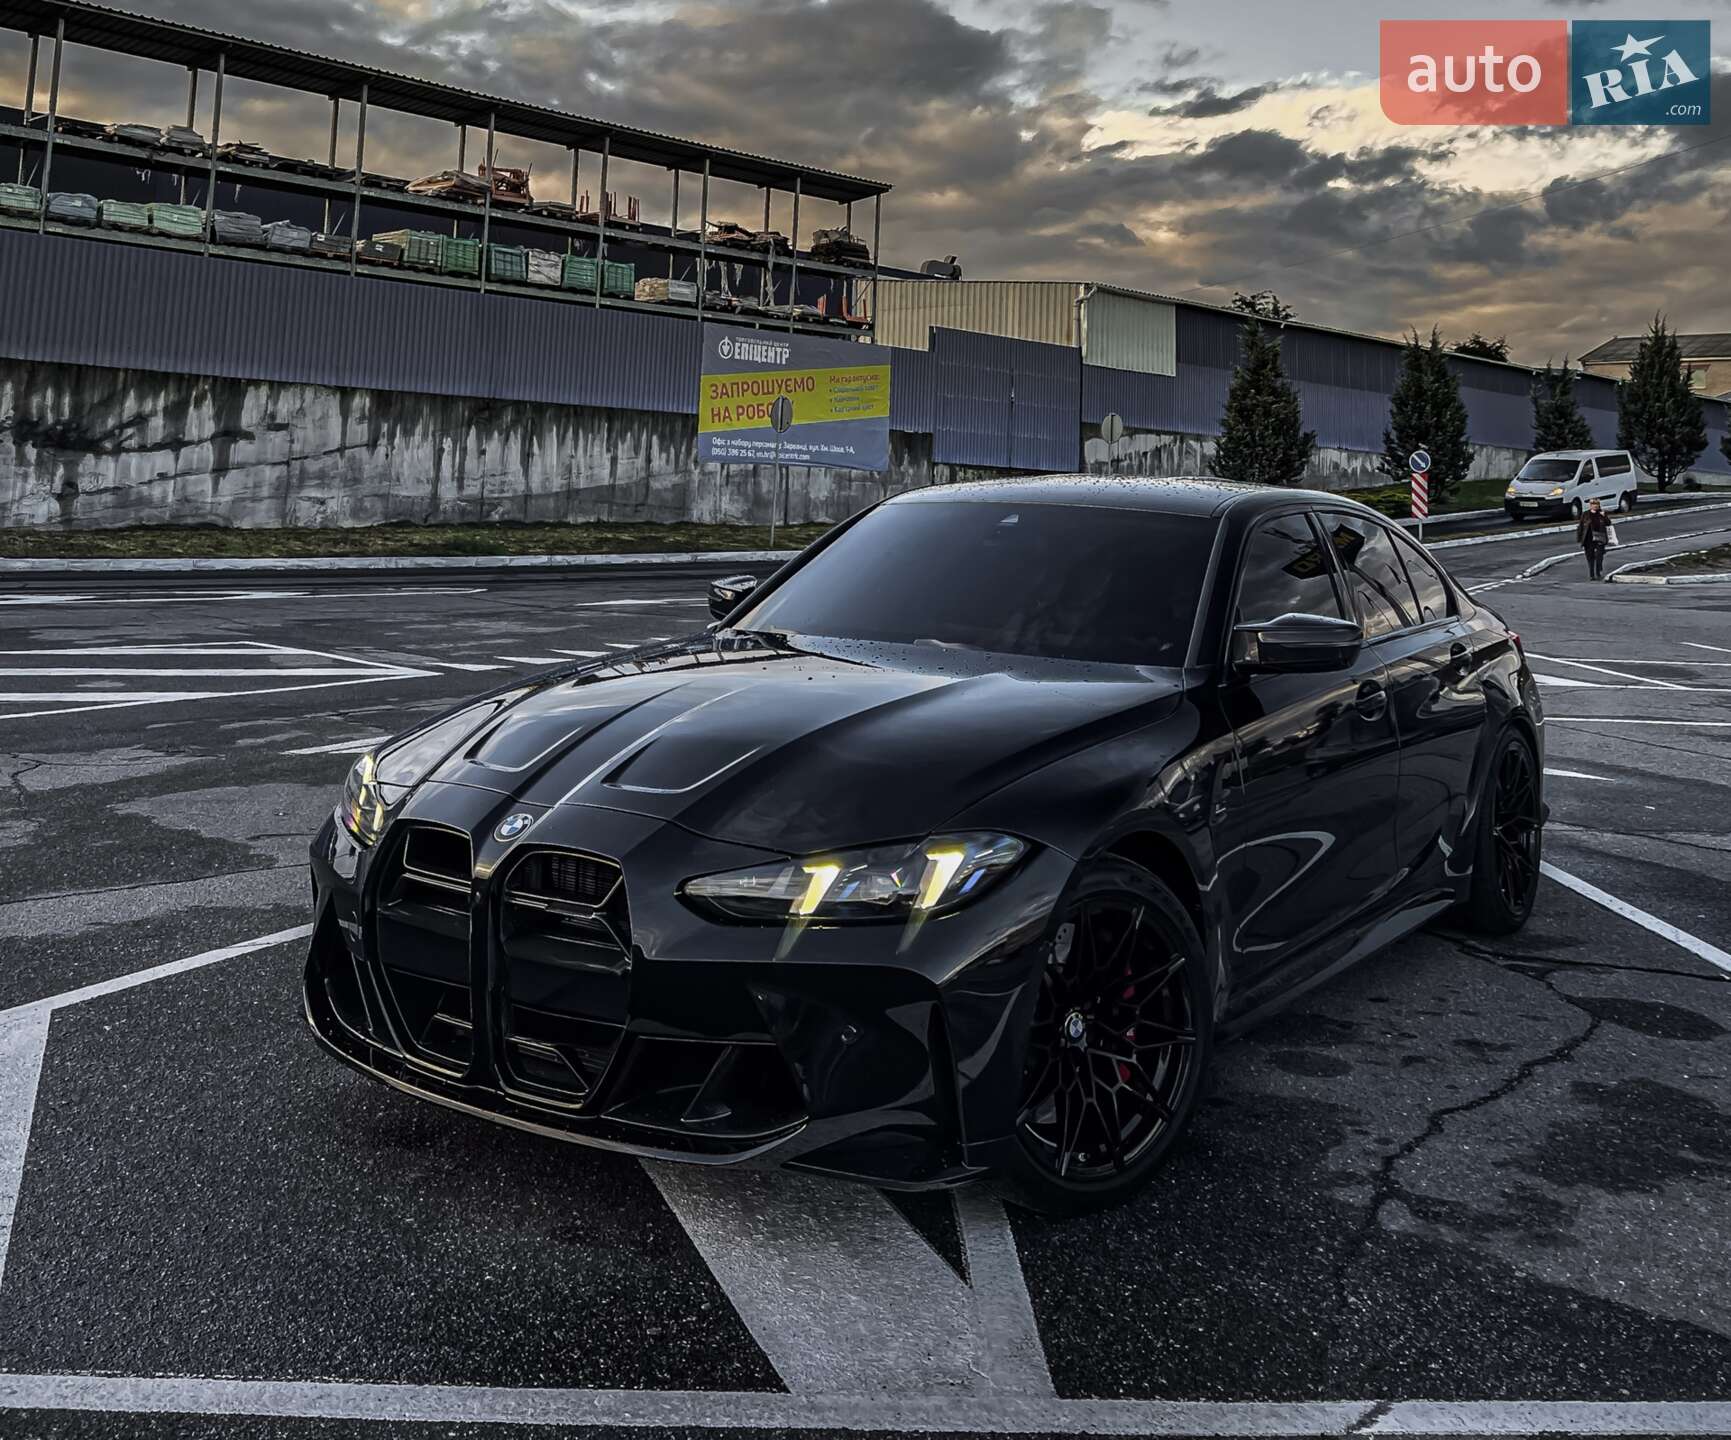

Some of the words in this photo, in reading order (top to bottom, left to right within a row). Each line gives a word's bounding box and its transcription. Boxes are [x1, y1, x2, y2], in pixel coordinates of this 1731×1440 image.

[734, 342, 790, 365] ЕПІЦЕНТР
[710, 376, 815, 400] ЗАПРОШУЄМО
[711, 406, 732, 423] НА
